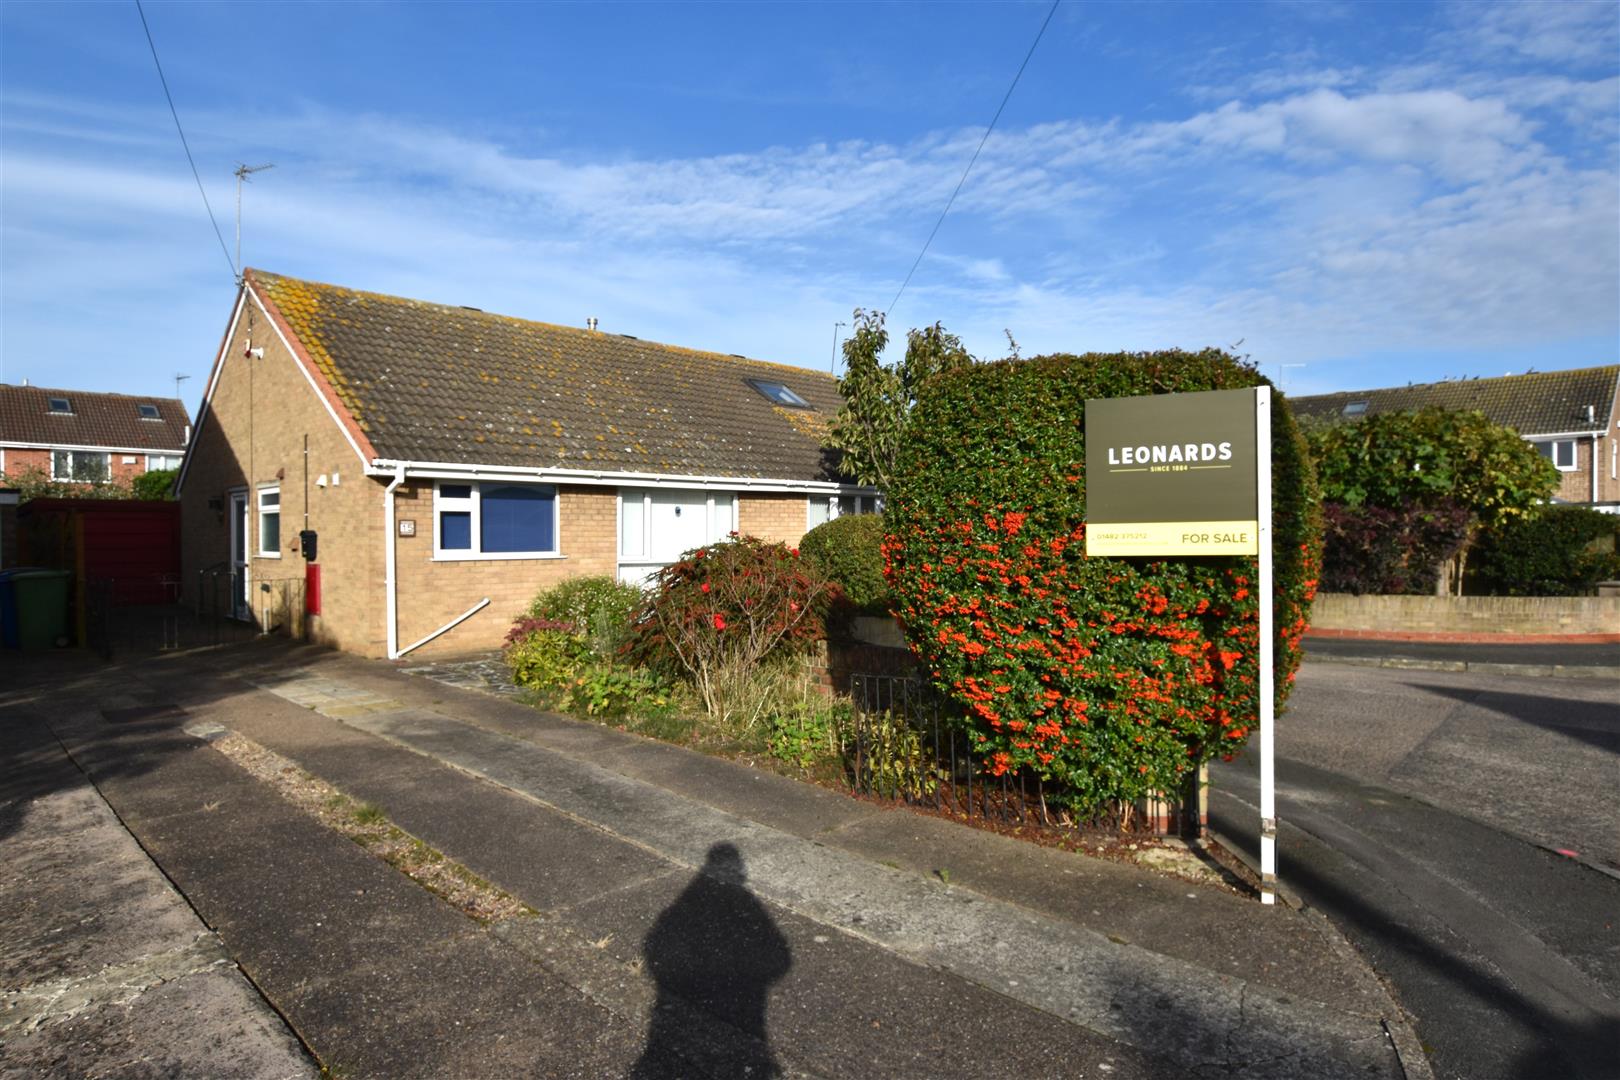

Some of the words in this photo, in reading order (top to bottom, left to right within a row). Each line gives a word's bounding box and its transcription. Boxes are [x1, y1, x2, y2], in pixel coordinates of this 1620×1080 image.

[1108, 442, 1232, 465] LEONARDS
[1182, 533, 1209, 544] FOR
[1213, 533, 1248, 543] SALE
